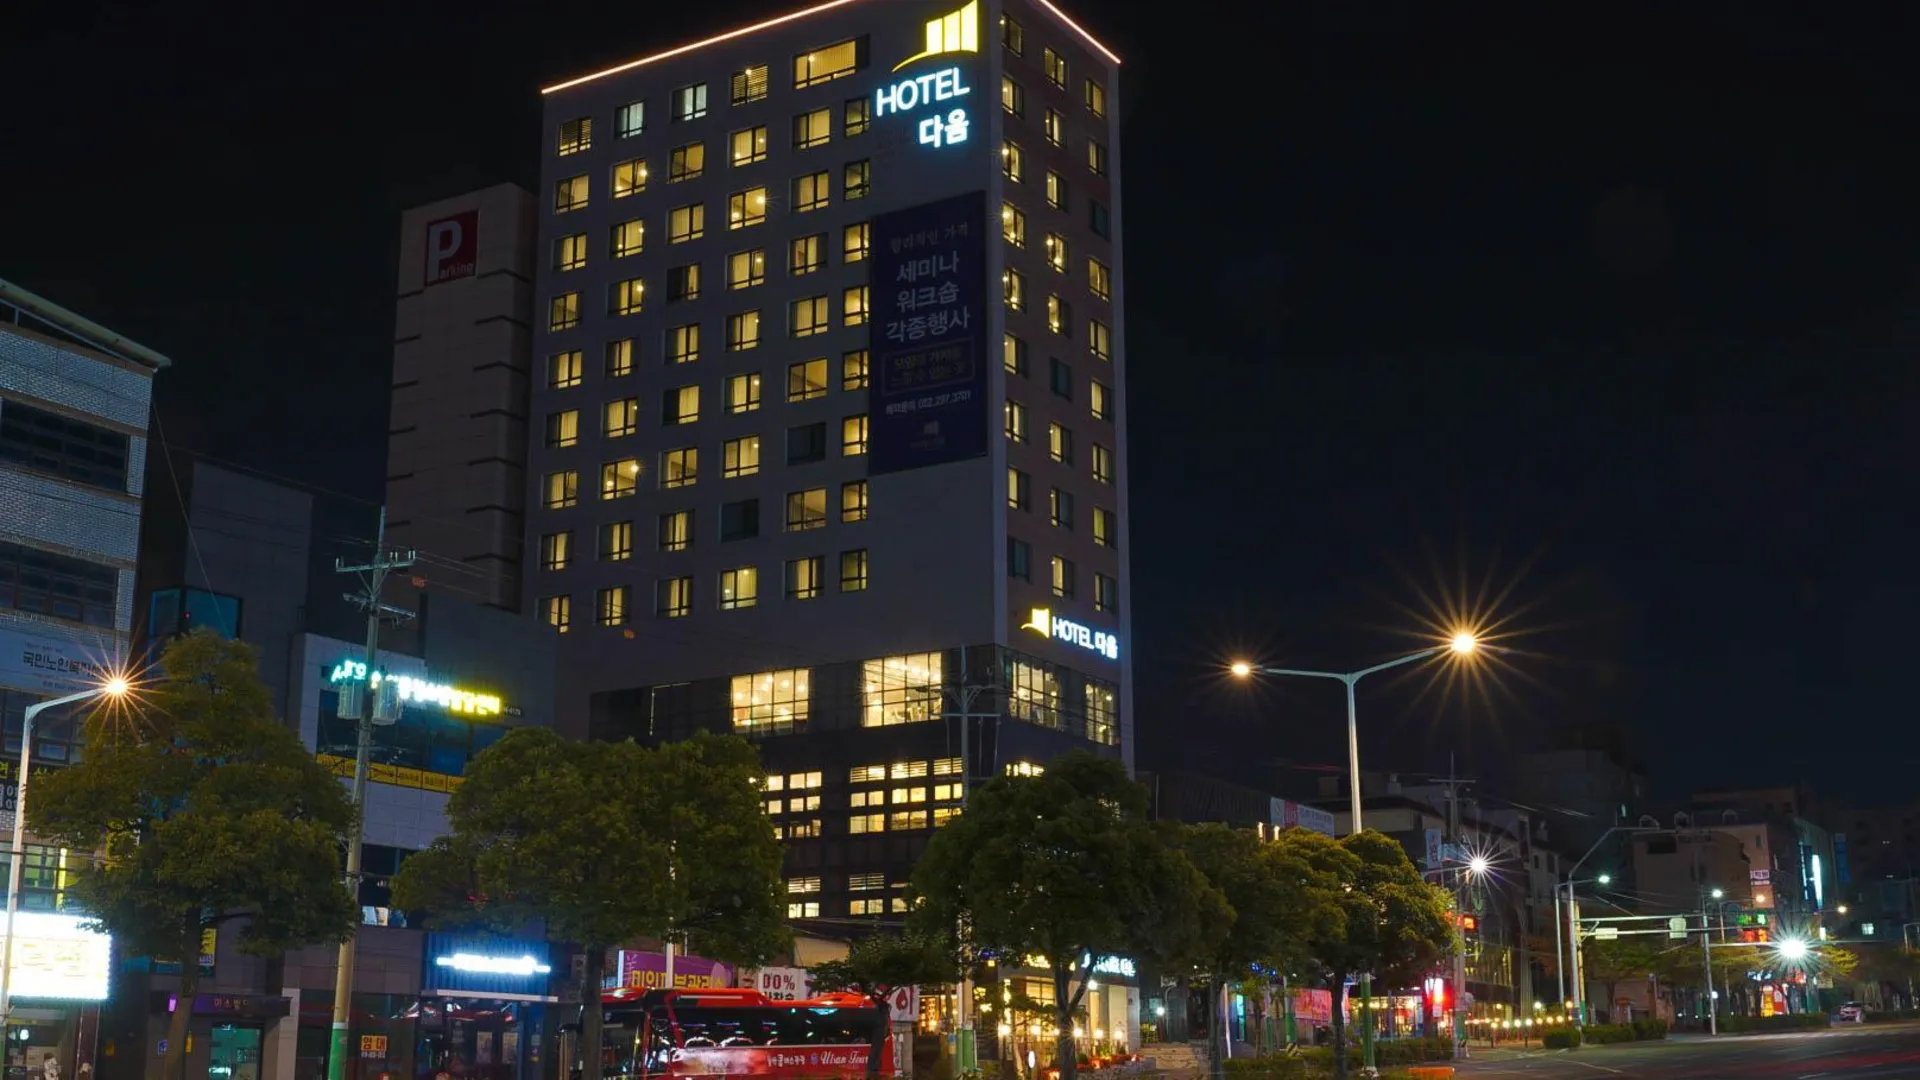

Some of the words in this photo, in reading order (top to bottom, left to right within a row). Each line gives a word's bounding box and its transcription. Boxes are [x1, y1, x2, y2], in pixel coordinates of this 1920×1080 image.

[876, 67, 971, 117] HOTEL
[895, 249, 960, 283] 세미나
[896, 280, 960, 313] 워크숍
[885, 305, 971, 342] 각종행사
[1052, 616, 1095, 650] HOTEL
